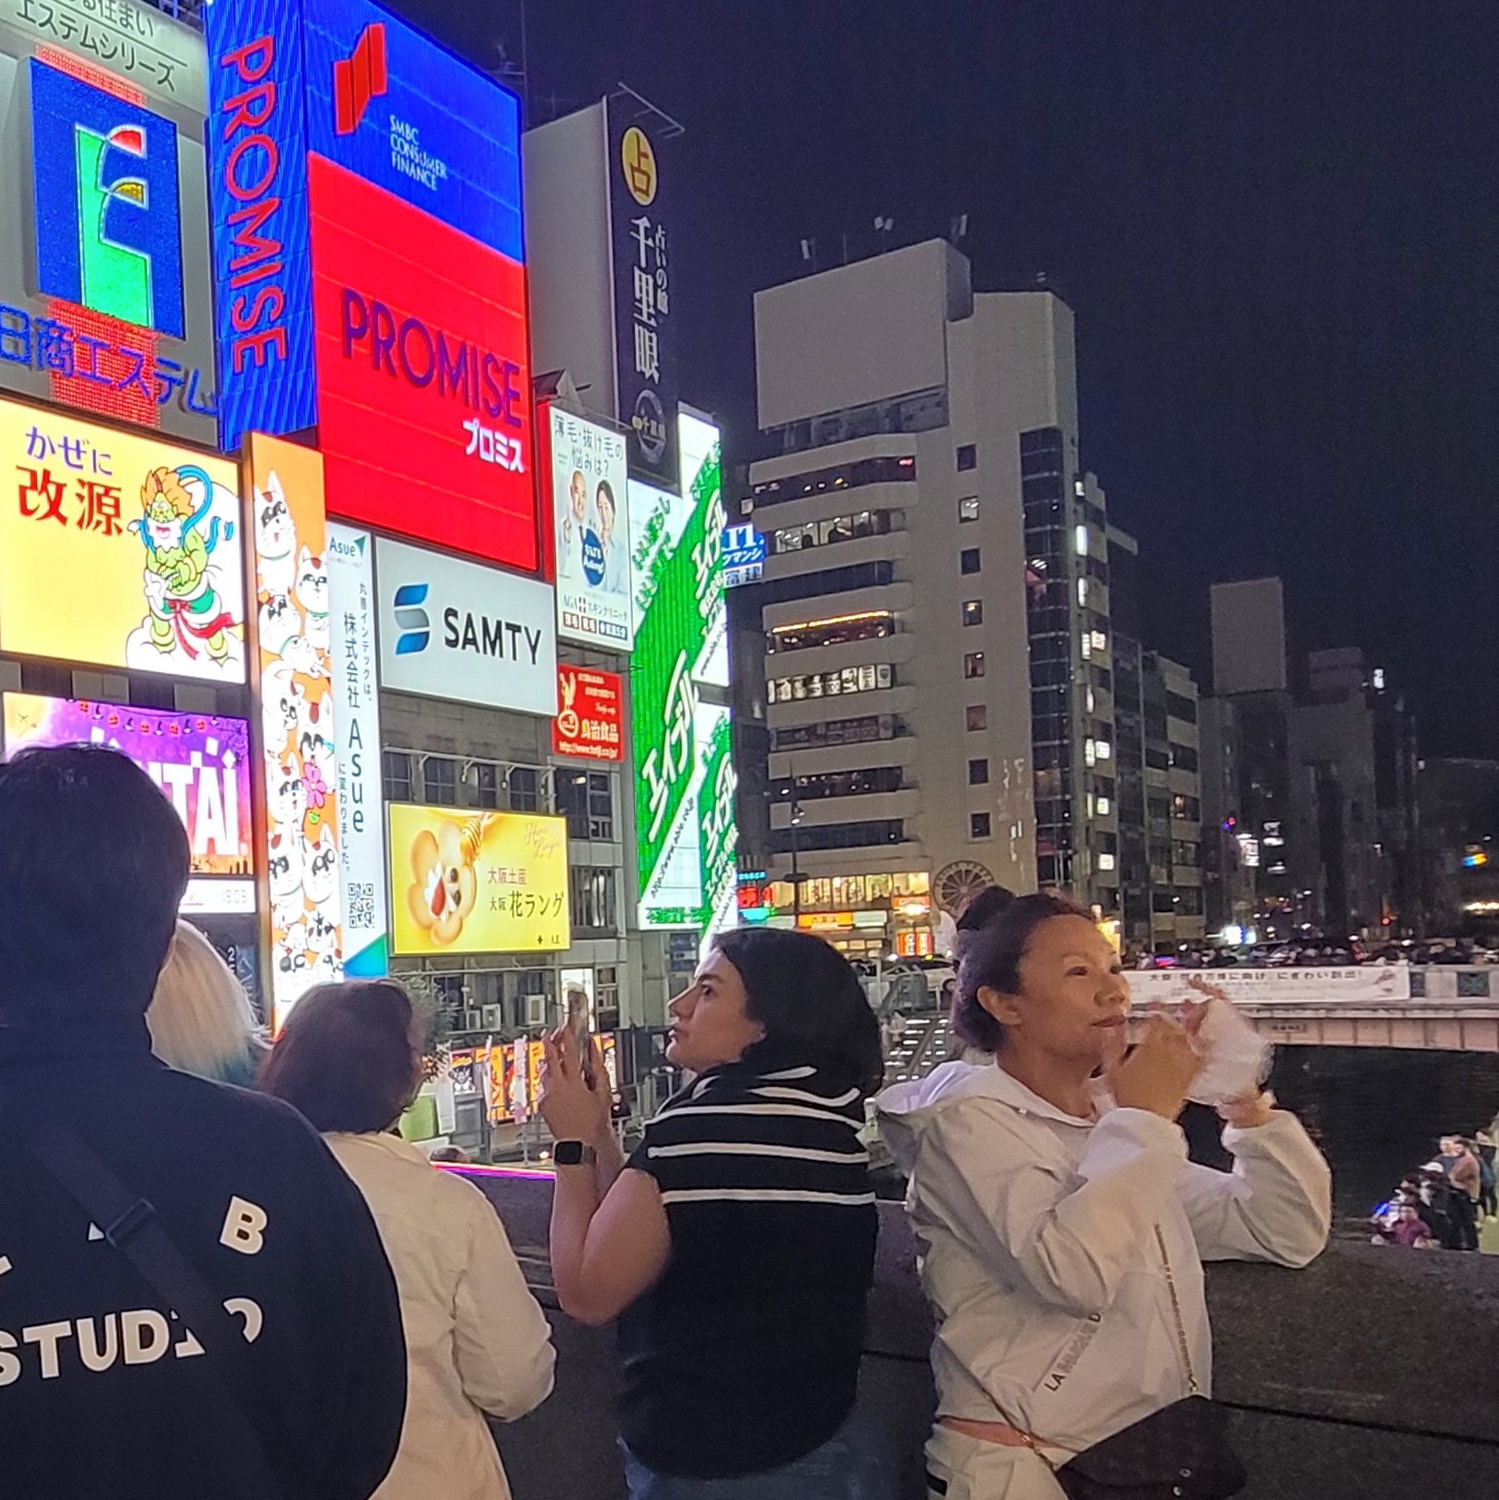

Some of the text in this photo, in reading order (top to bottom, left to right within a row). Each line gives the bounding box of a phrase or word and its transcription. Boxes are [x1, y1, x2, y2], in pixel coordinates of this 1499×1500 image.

[16, 4, 175, 92] エステムシリーズ
[390, 114, 419, 146] SMBC
[390, 133, 448, 180] CONSUMER
[392, 150, 437, 191] FINANCE
[221, 34, 288, 375] PROMISE
[630, 216, 660, 386] 千里眼
[341, 287, 522, 429] PROMISE
[24, 424, 114, 477] かぜに
[463, 418, 526, 474] プロミス
[15, 464, 124, 537] 改源
[329, 536, 357, 557] Asue
[443, 606, 542, 666] SAMTY
[343, 610, 364, 833] 株式会社 Asue
[641, 648, 699, 844] エイブル
